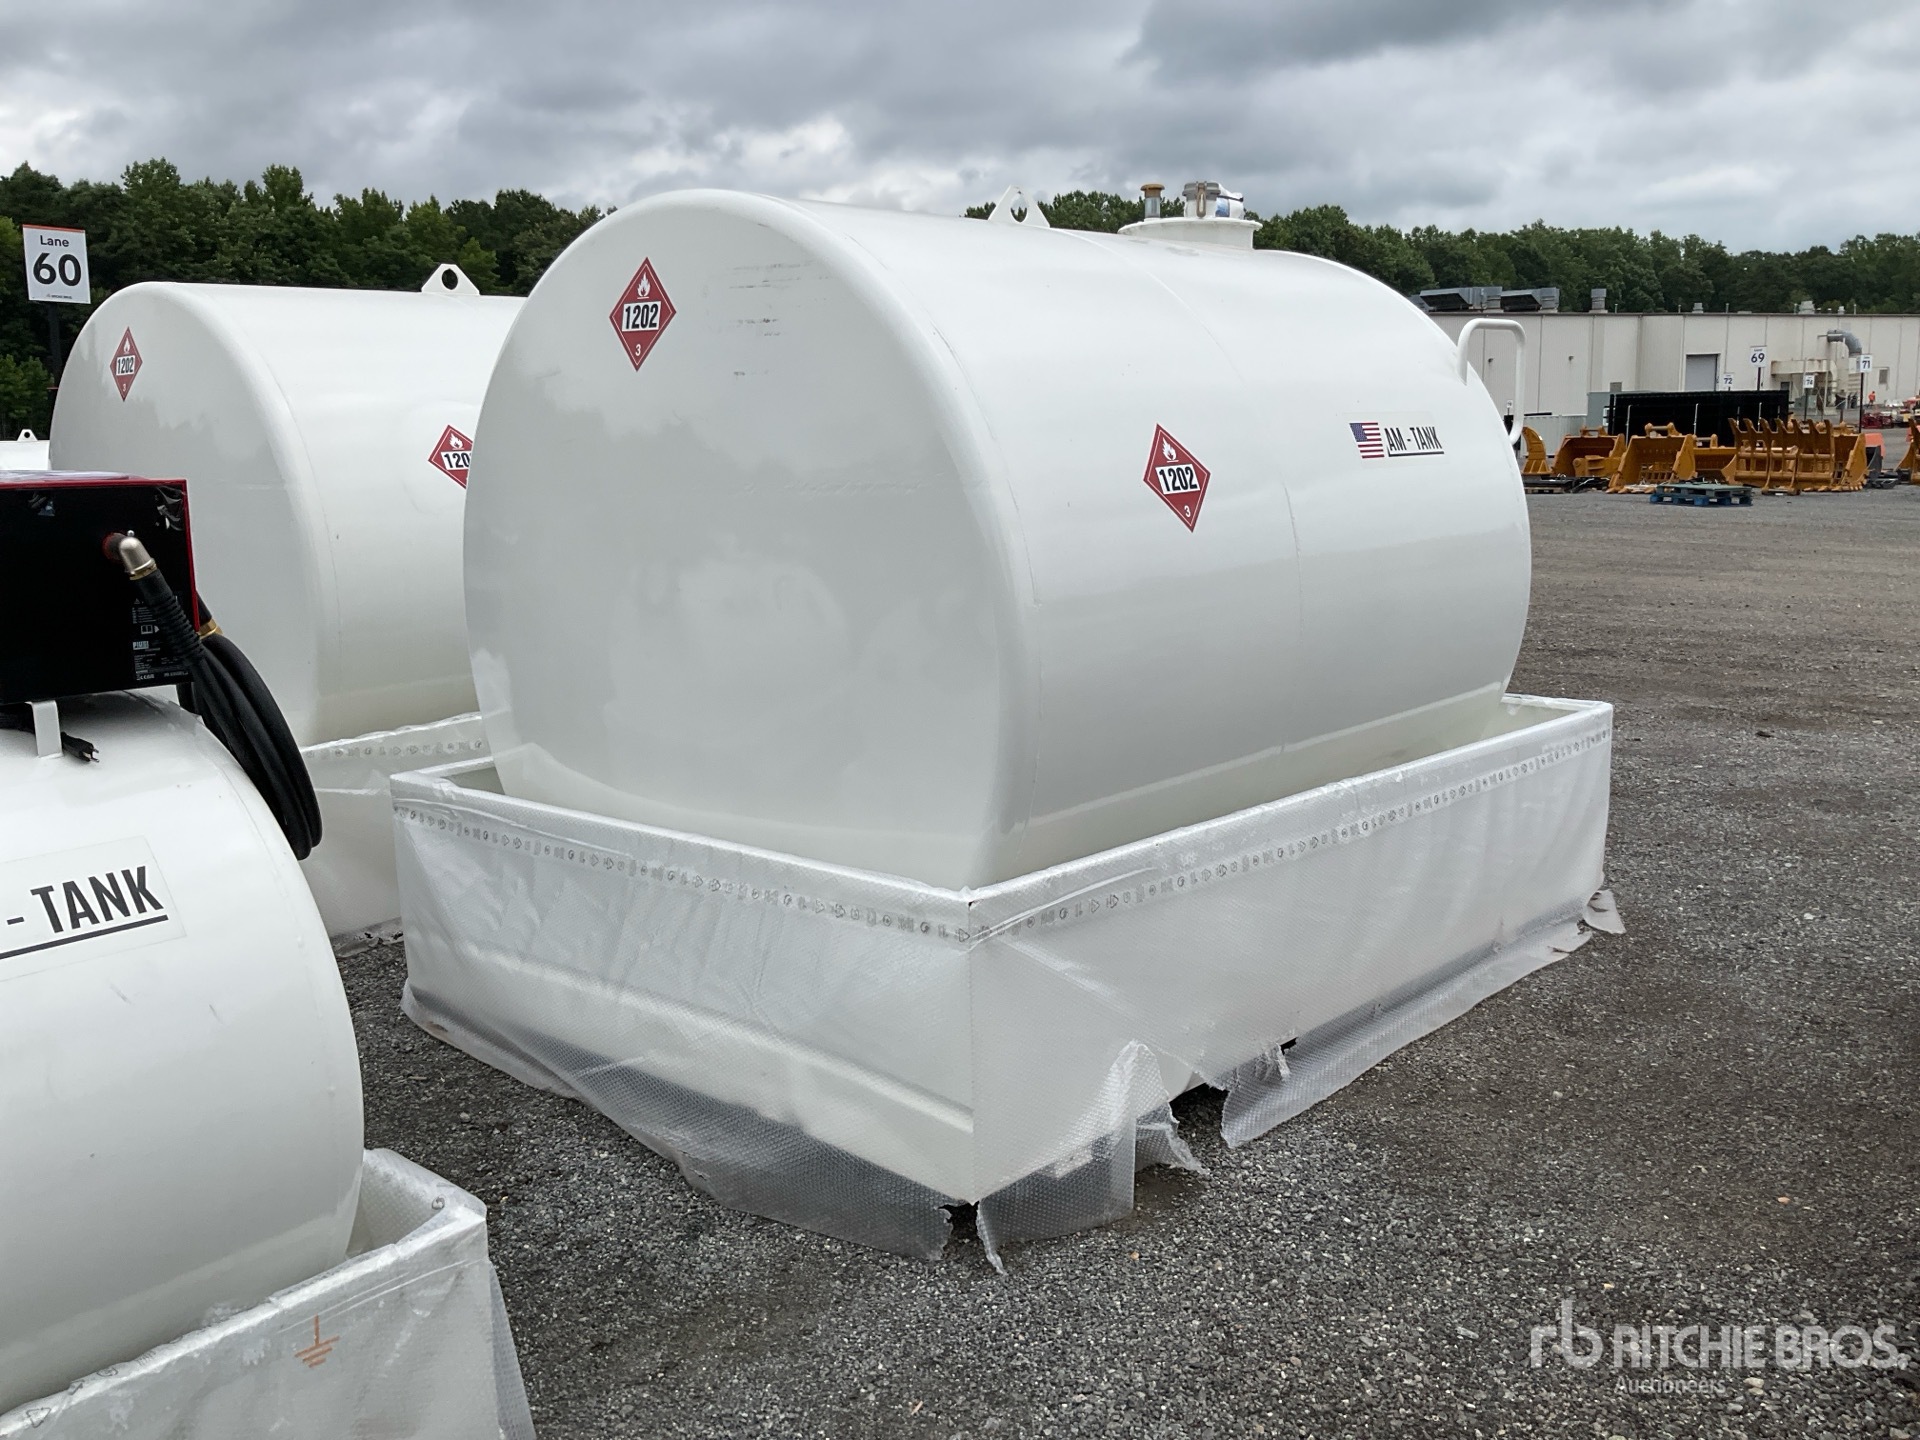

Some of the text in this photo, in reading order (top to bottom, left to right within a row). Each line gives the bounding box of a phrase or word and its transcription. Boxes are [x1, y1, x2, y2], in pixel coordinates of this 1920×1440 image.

[40, 235, 69, 247] Lane
[33, 252, 82, 287] 60
[625, 303, 659, 330] 1202
[635, 343, 642, 356] 3
[1750, 352, 1765, 363] 69
[1862, 360, 1871, 369] 71
[117, 357, 134, 375] 1202
[122, 383, 127, 392] 3
[1723, 377, 1733, 385] 72
[1384, 427, 1407, 451] AM
[1409, 426, 1443, 450] TANK
[443, 452, 472, 469] 120
[1158, 466, 1199, 492] 1202
[1184, 505, 1191, 518] 3
[30, 865, 165, 934] TANK
